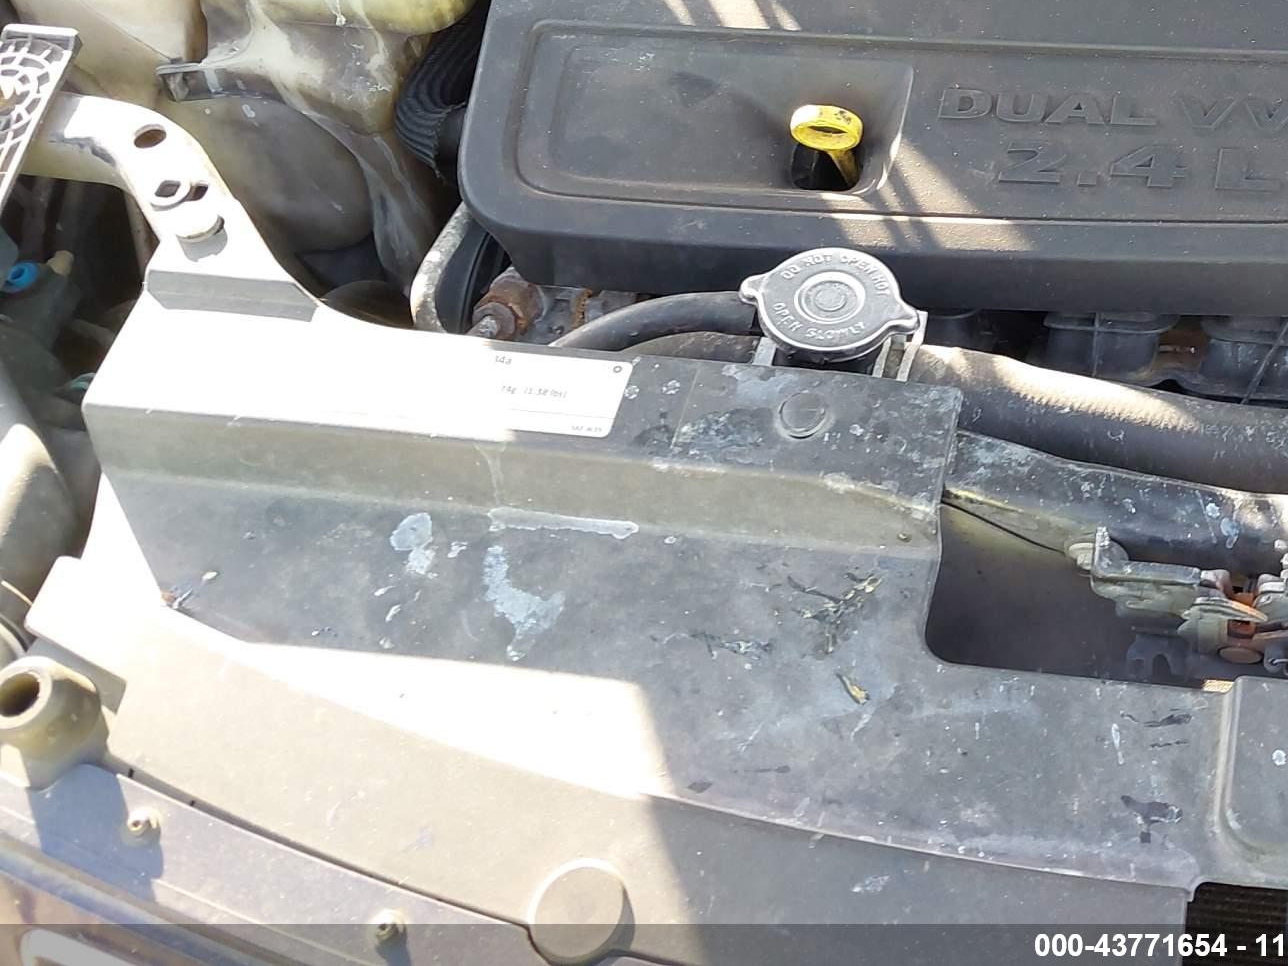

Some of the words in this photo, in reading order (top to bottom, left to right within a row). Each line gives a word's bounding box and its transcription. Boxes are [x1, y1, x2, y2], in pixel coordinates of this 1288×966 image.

[938, 88, 1159, 127] DUAL
[998, 141, 1190, 189] 2.4
[1214, 147, 1283, 193] L
[781, 265, 800, 280] DO
[802, 254, 832, 266] NOT
[839, 255, 875, 275] OPEN
[872, 272, 890, 297] HOT
[772, 301, 803, 331] OPEN
[806, 321, 865, 341] SLOWLY
